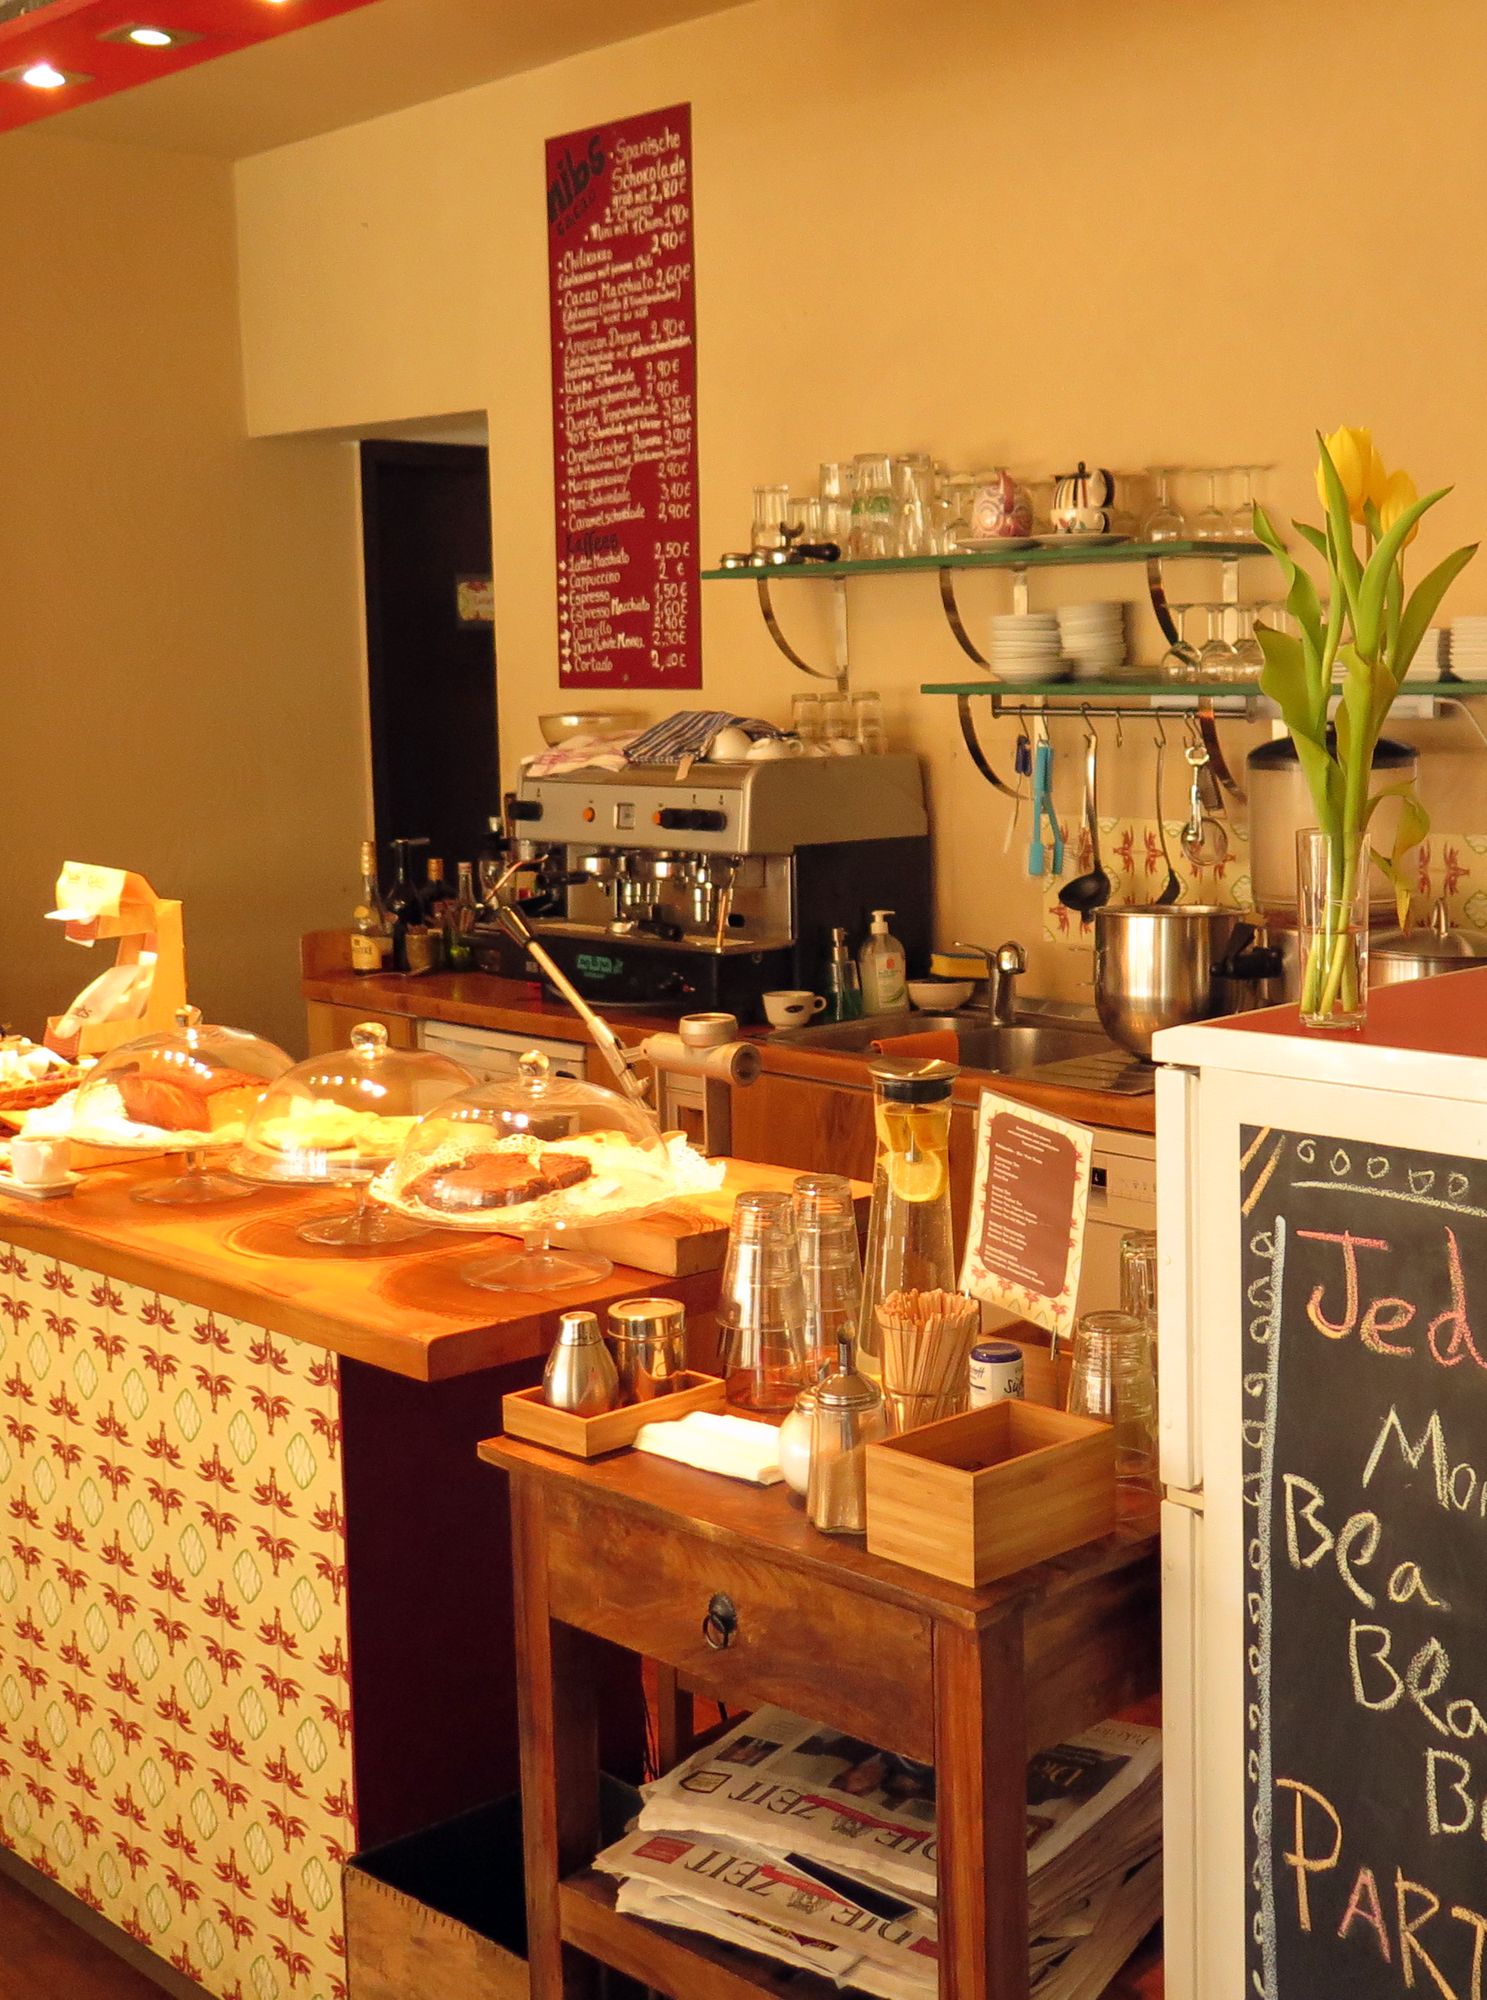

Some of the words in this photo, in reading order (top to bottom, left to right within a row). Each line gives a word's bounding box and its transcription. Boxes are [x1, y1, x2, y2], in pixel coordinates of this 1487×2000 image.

[564, 290, 599, 309] Cacao
[569, 571, 621, 592] Cappuccino
[569, 590, 611, 609] Espresso
[1363, 1403, 1487, 1517] Mo
[728, 1780, 816, 1821] ZEIT
[1425, 1747, 1487, 1841] B
[684, 1851, 770, 1897] ZEIT
